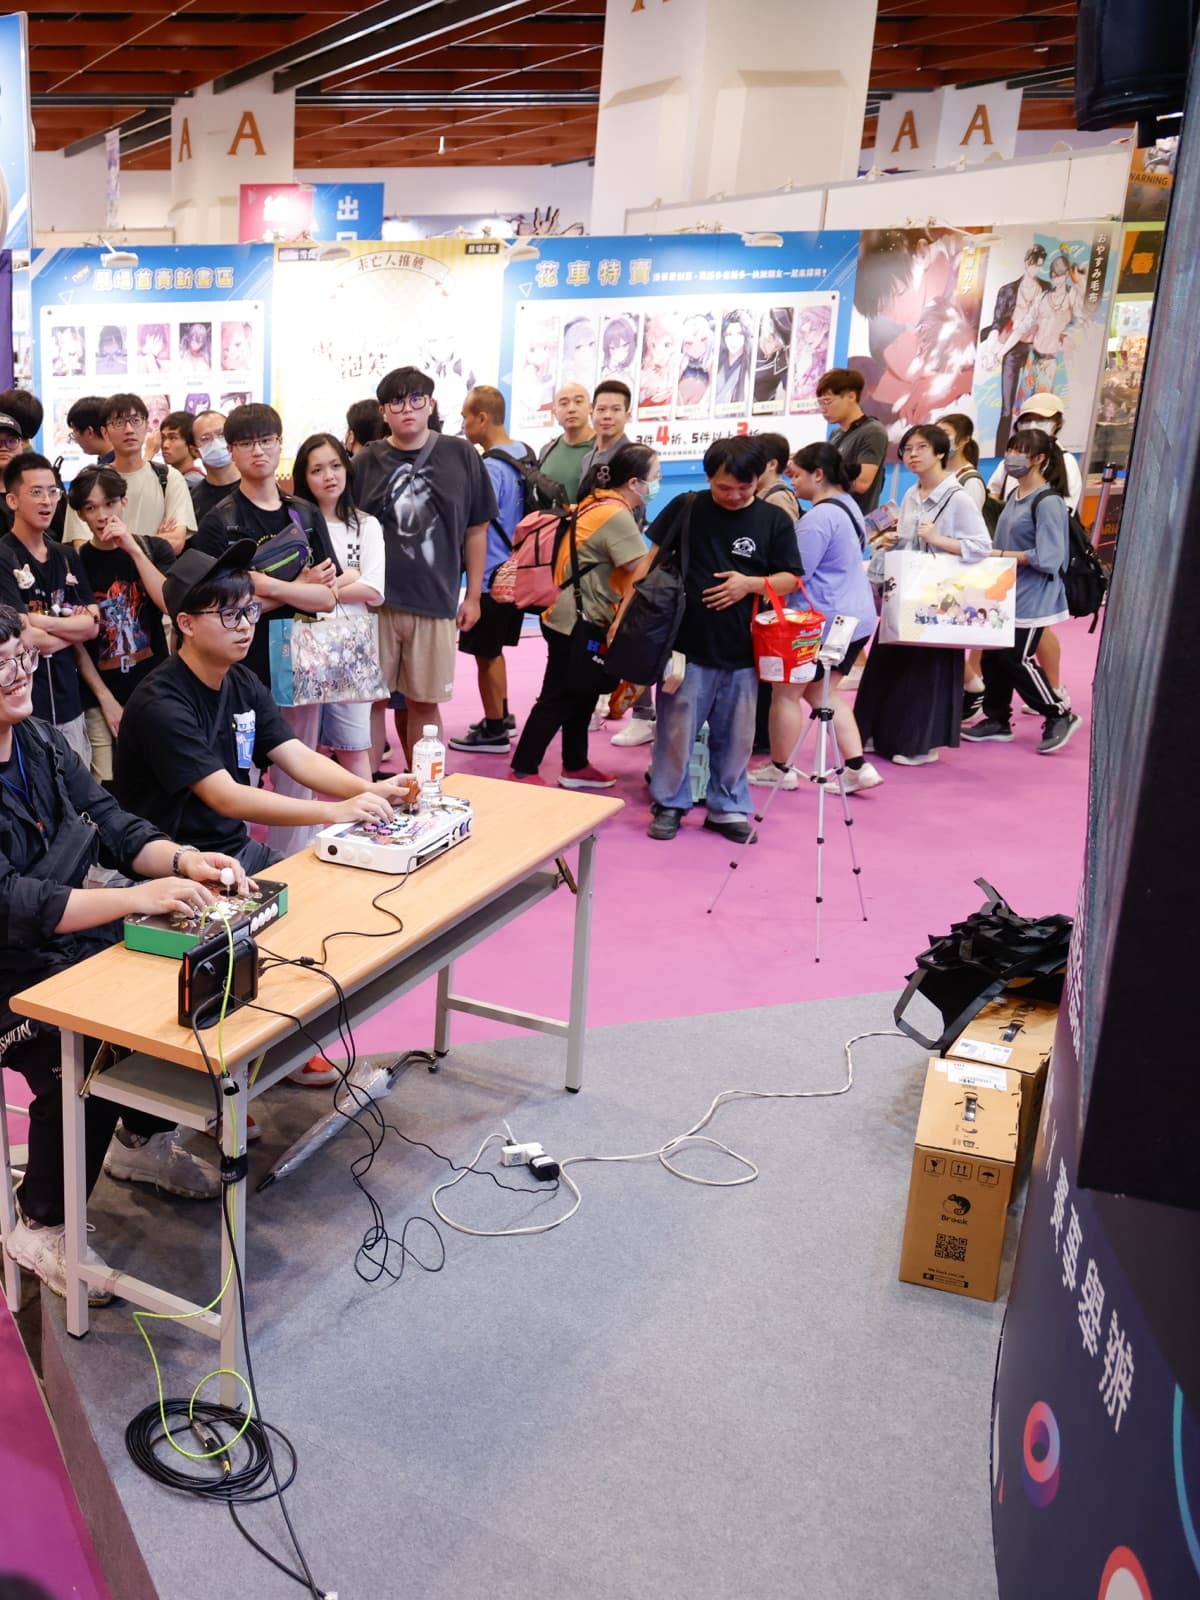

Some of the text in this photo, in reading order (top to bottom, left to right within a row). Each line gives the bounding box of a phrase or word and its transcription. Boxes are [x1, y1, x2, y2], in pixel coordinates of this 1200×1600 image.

[178, 118, 192, 163] A
[227, 111, 266, 156] A
[891, 110, 919, 153] A
[960, 104, 993, 146] A
[358, 253, 425, 272] 未亡人推薦
[536, 259, 653, 288] 花車特賣
[941, 1214, 969, 1225] Brook
